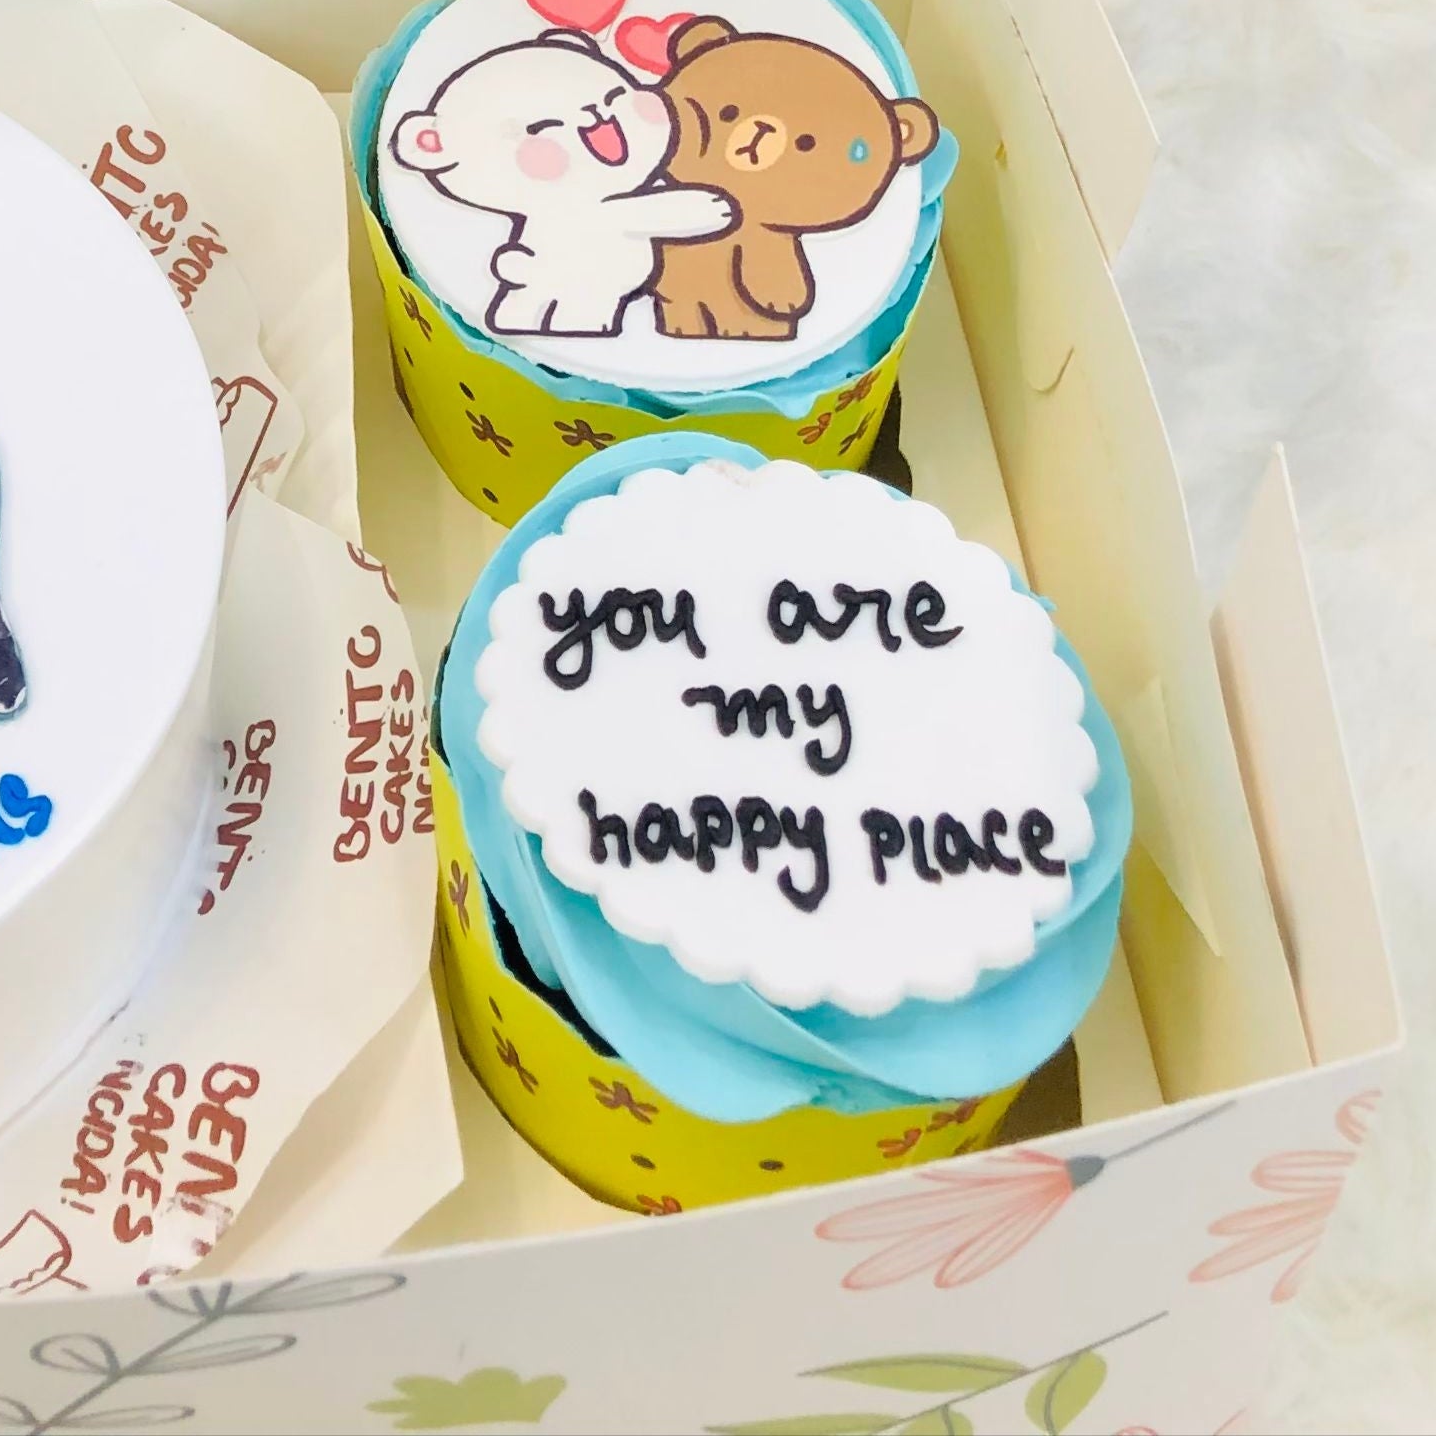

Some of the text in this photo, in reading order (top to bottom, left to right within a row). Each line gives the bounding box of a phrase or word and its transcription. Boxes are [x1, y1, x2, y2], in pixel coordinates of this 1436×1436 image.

[538, 579, 964, 691] you are
[380, 668, 415, 845] CAKES
[682, 684, 853, 776] my
[204, 719, 277, 909] BENT
[578, 788, 1067, 914] happy place
[113, 1062, 187, 1244] CAKES
